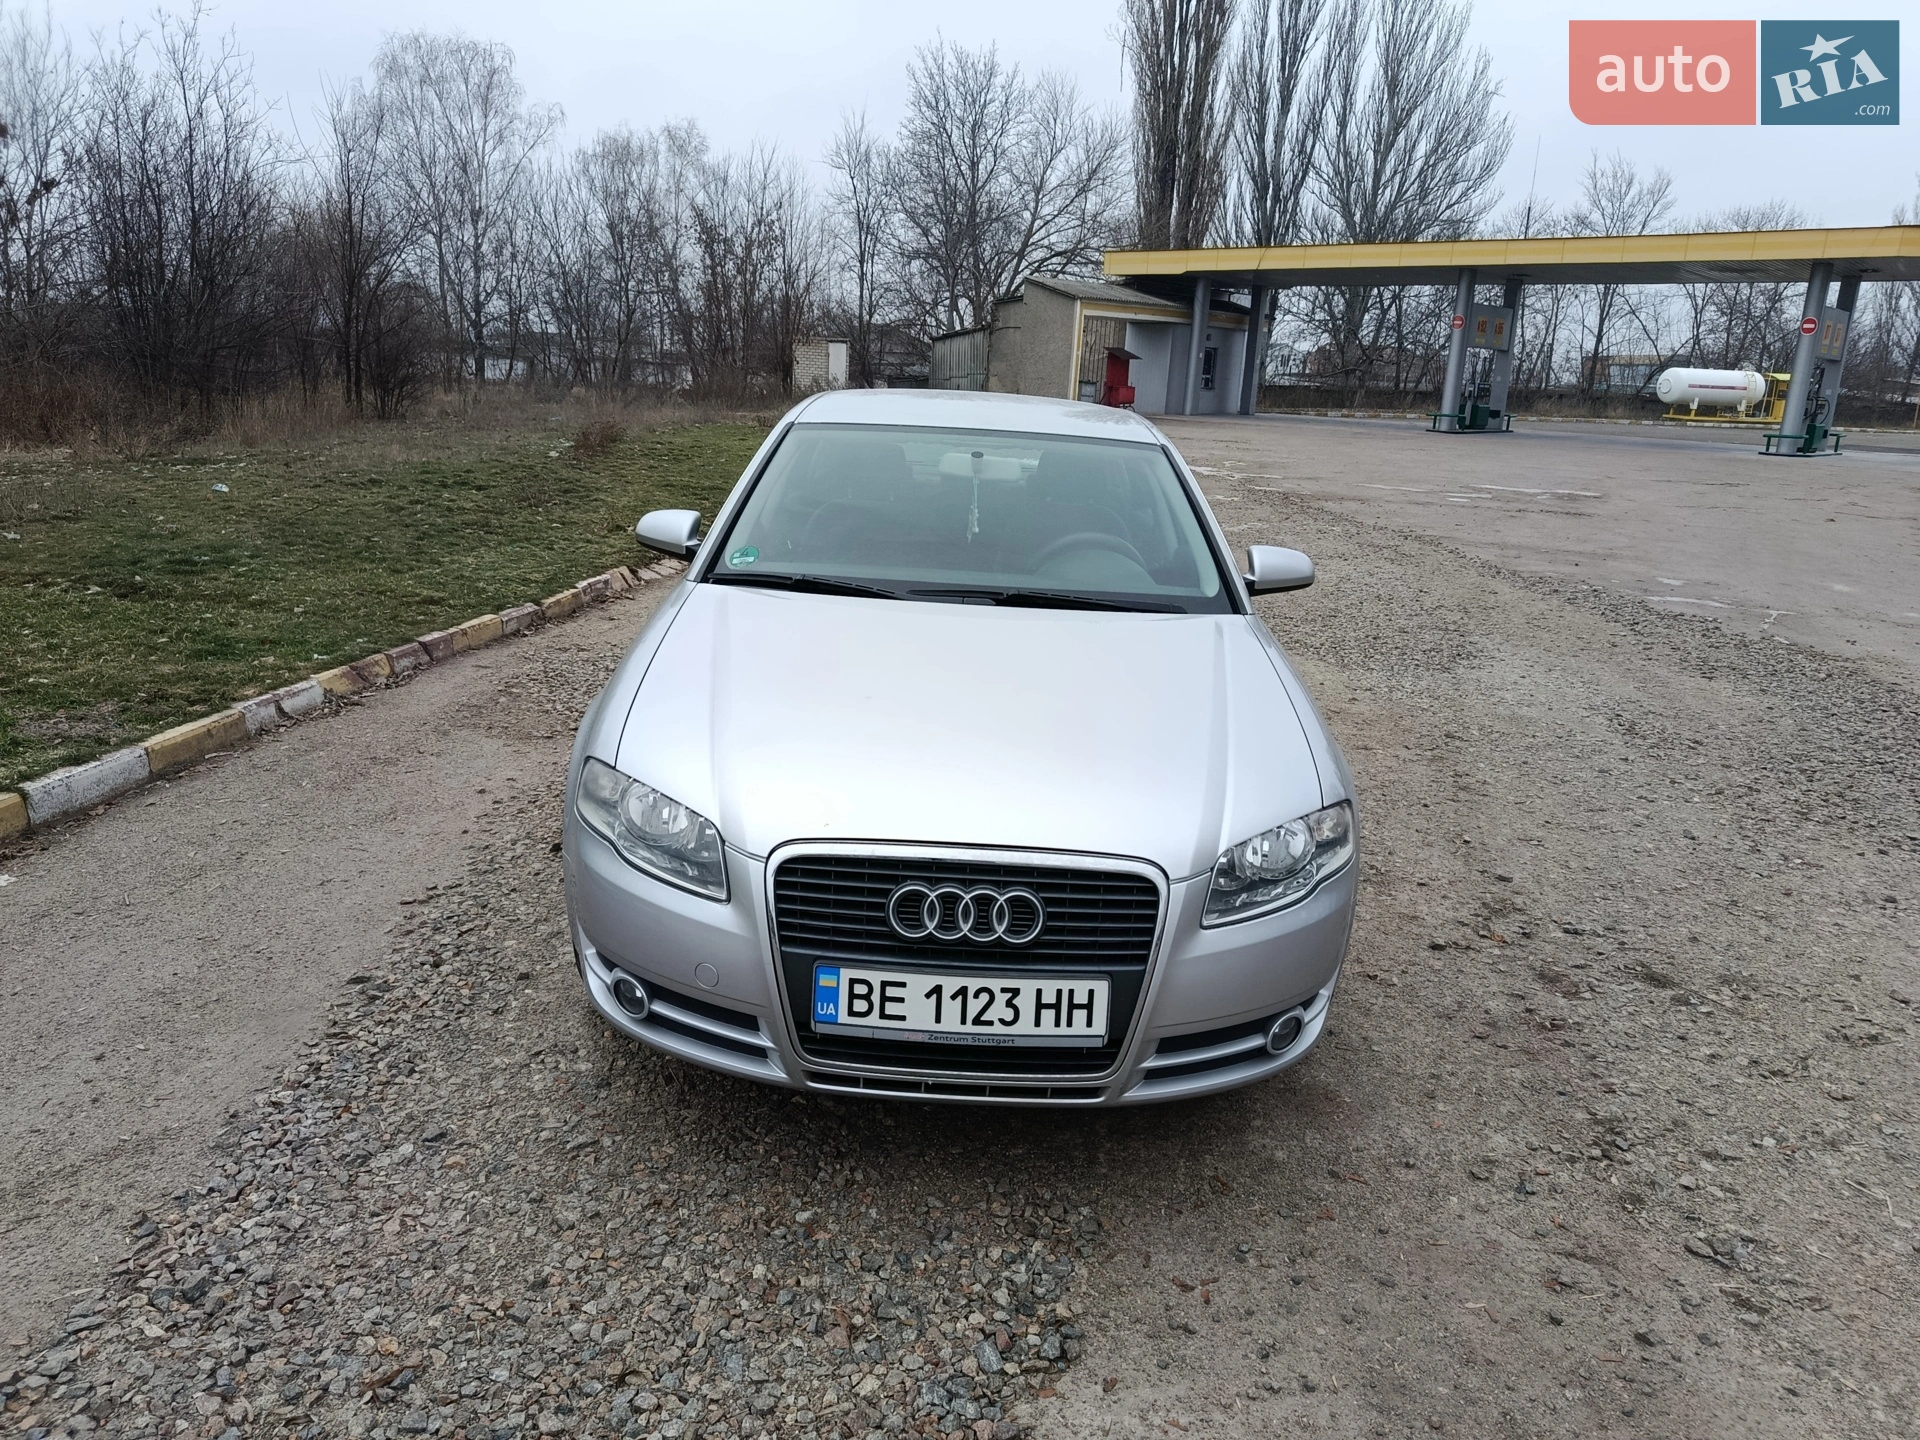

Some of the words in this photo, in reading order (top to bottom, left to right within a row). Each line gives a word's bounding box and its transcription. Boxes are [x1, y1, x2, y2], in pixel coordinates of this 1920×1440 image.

[741, 547, 749, 556] 4
[817, 1002, 836, 1016] UA
[847, 977, 907, 1022] BE
[924, 983, 1021, 1027] 1123
[1033, 988, 1095, 1028] HH
[927, 1033, 969, 1043] Zentrum
[971, 1036, 1016, 1046] Stuttgart
